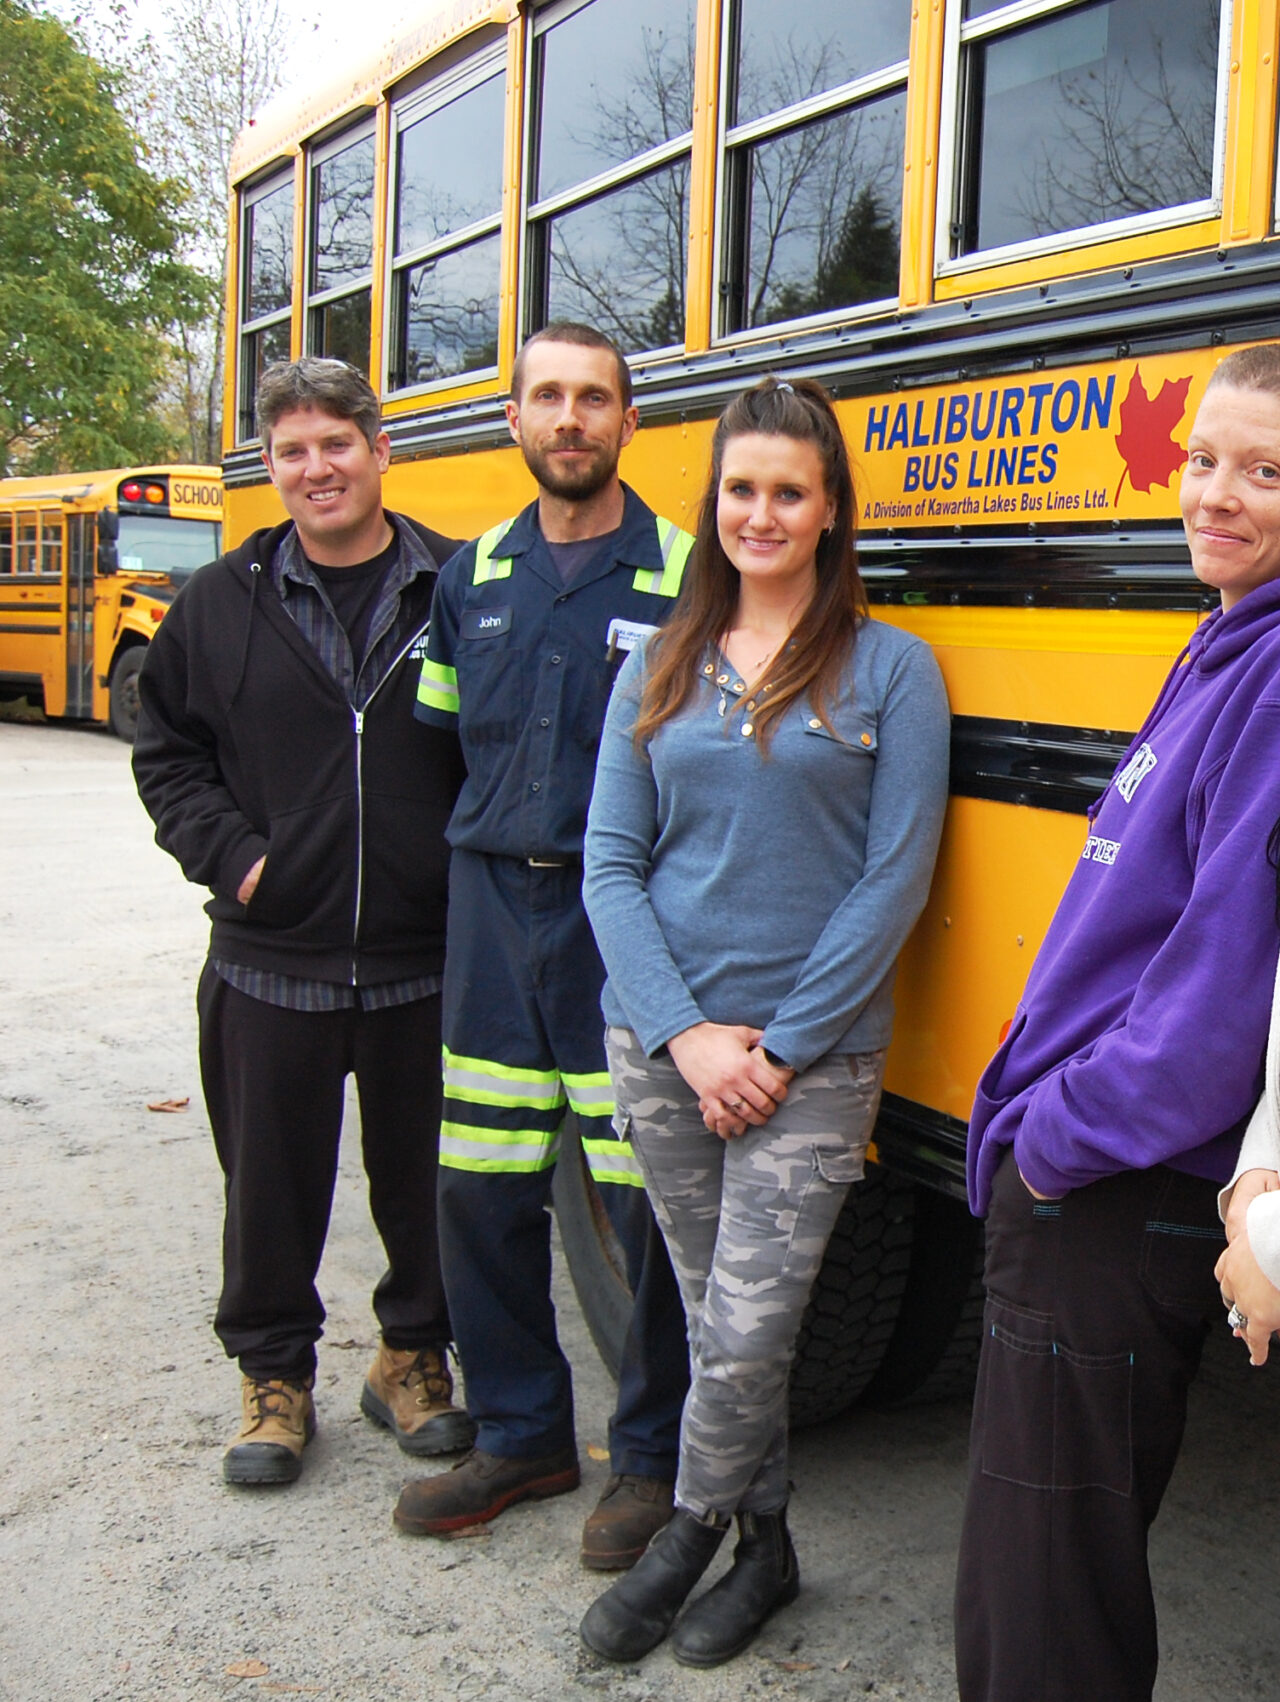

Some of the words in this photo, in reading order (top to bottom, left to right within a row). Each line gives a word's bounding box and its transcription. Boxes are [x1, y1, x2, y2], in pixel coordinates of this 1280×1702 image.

[864, 374, 1116, 452] HALIBURTON
[903, 452, 959, 492] BUS
[967, 443, 1058, 489] LINES
[864, 502, 871, 519] A
[873, 500, 912, 519] Division
[915, 498, 926, 516] of
[928, 496, 980, 516] Kawartha
[983, 493, 1016, 513] Lakes
[1020, 492, 1043, 511] Bus
[1046, 491, 1080, 510] Lines
[1084, 488, 1109, 508] Ltd.
[479, 615, 501, 628] John
